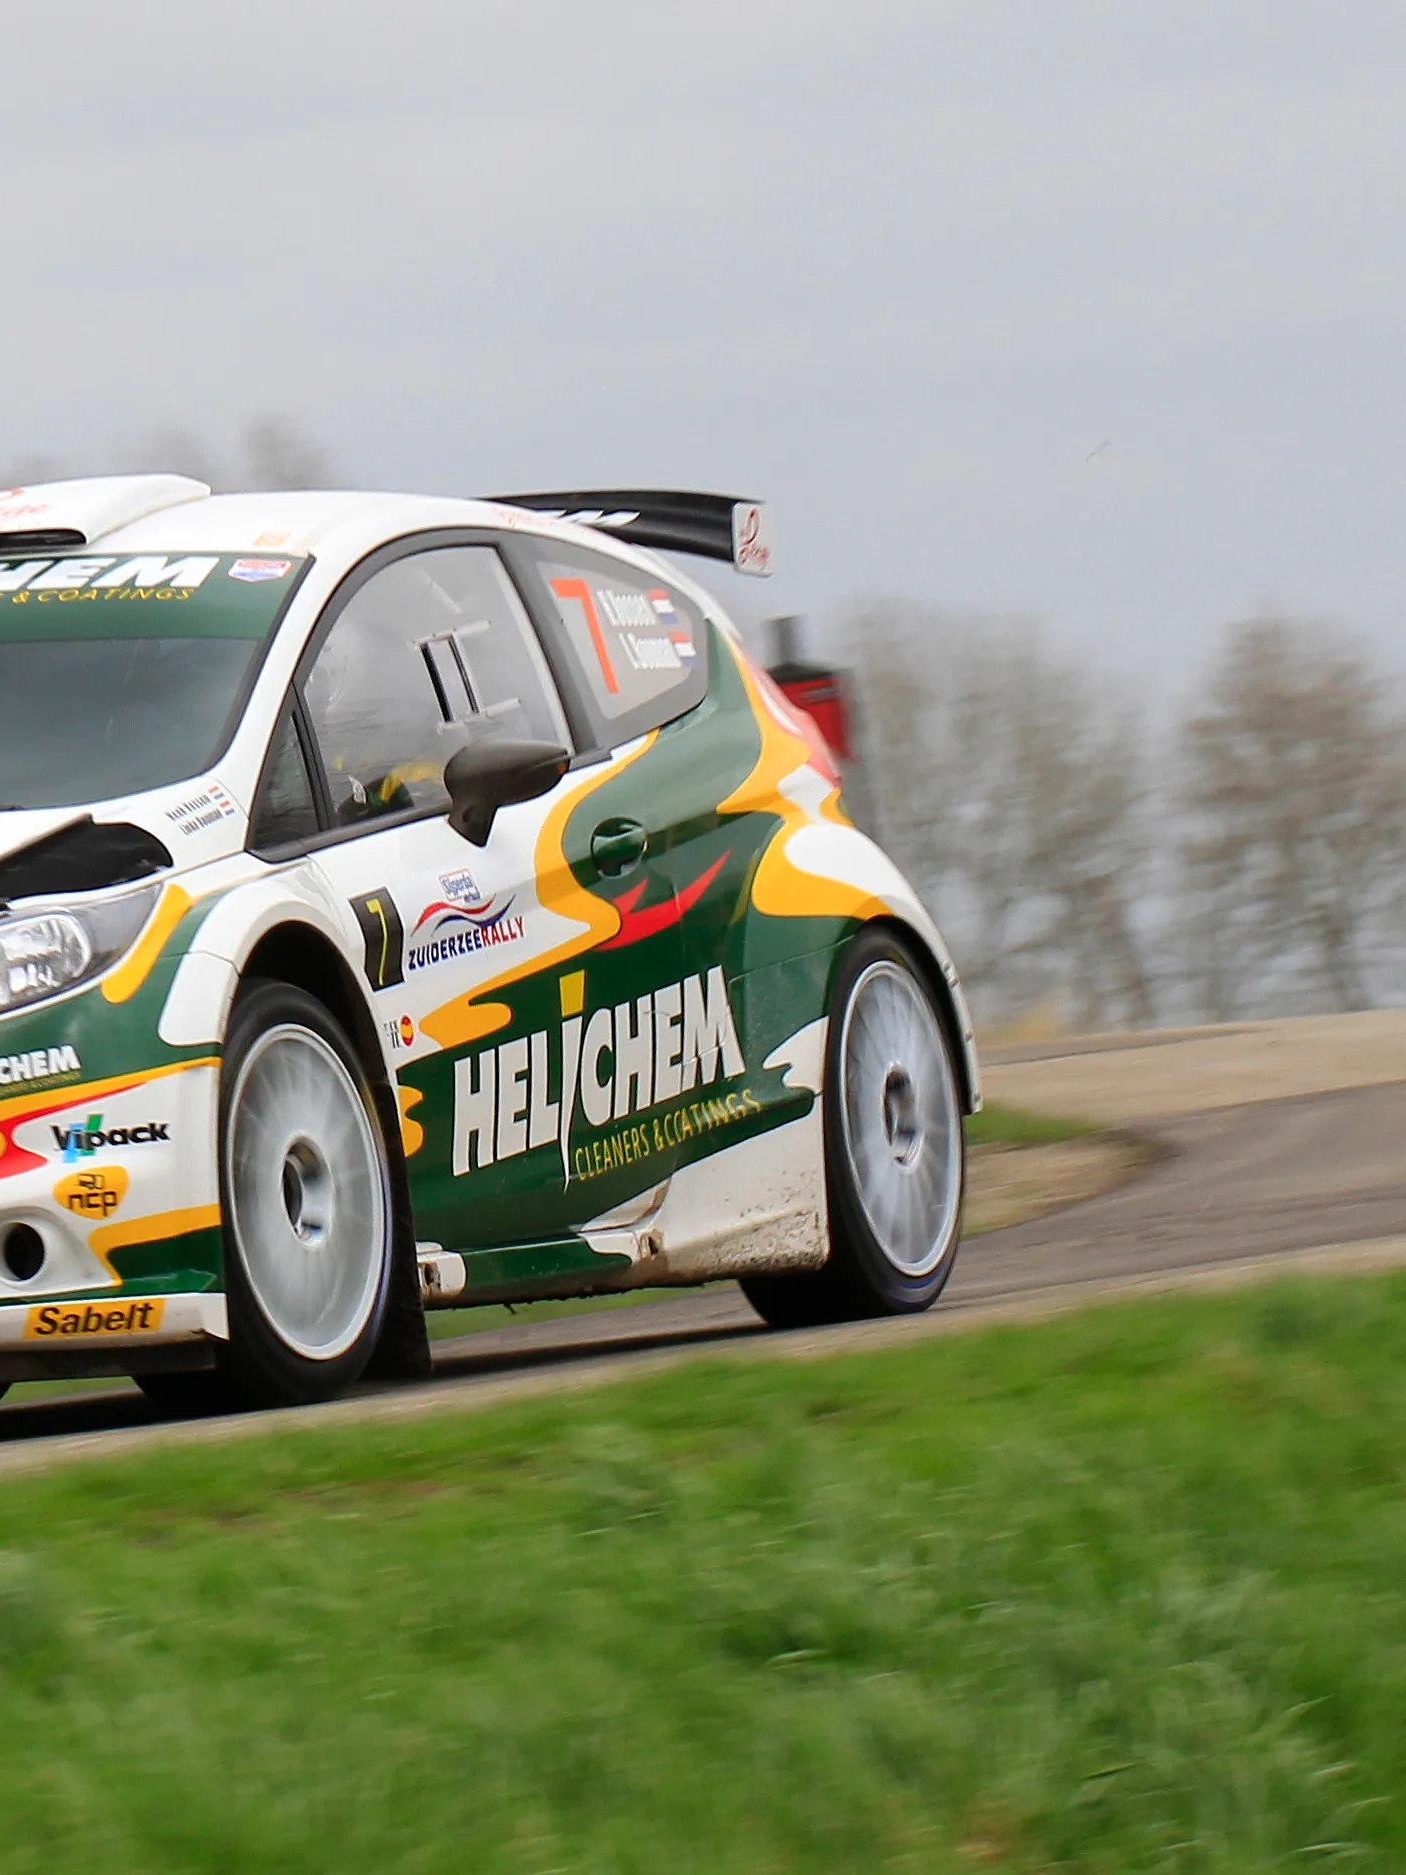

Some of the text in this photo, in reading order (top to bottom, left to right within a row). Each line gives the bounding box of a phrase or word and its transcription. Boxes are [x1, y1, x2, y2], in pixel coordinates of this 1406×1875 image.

[12, 590, 31, 604] &
[37, 588, 195, 602] COATINGS
[549, 578, 620, 694] 7
[365, 898, 389, 986] 7
[408, 915, 526, 971] ZUIDERZEERALLY
[50, 1113, 172, 1163] Vipack
[575, 1123, 651, 1182] CLEANERS
[34, 1301, 155, 1336] Sabelt
